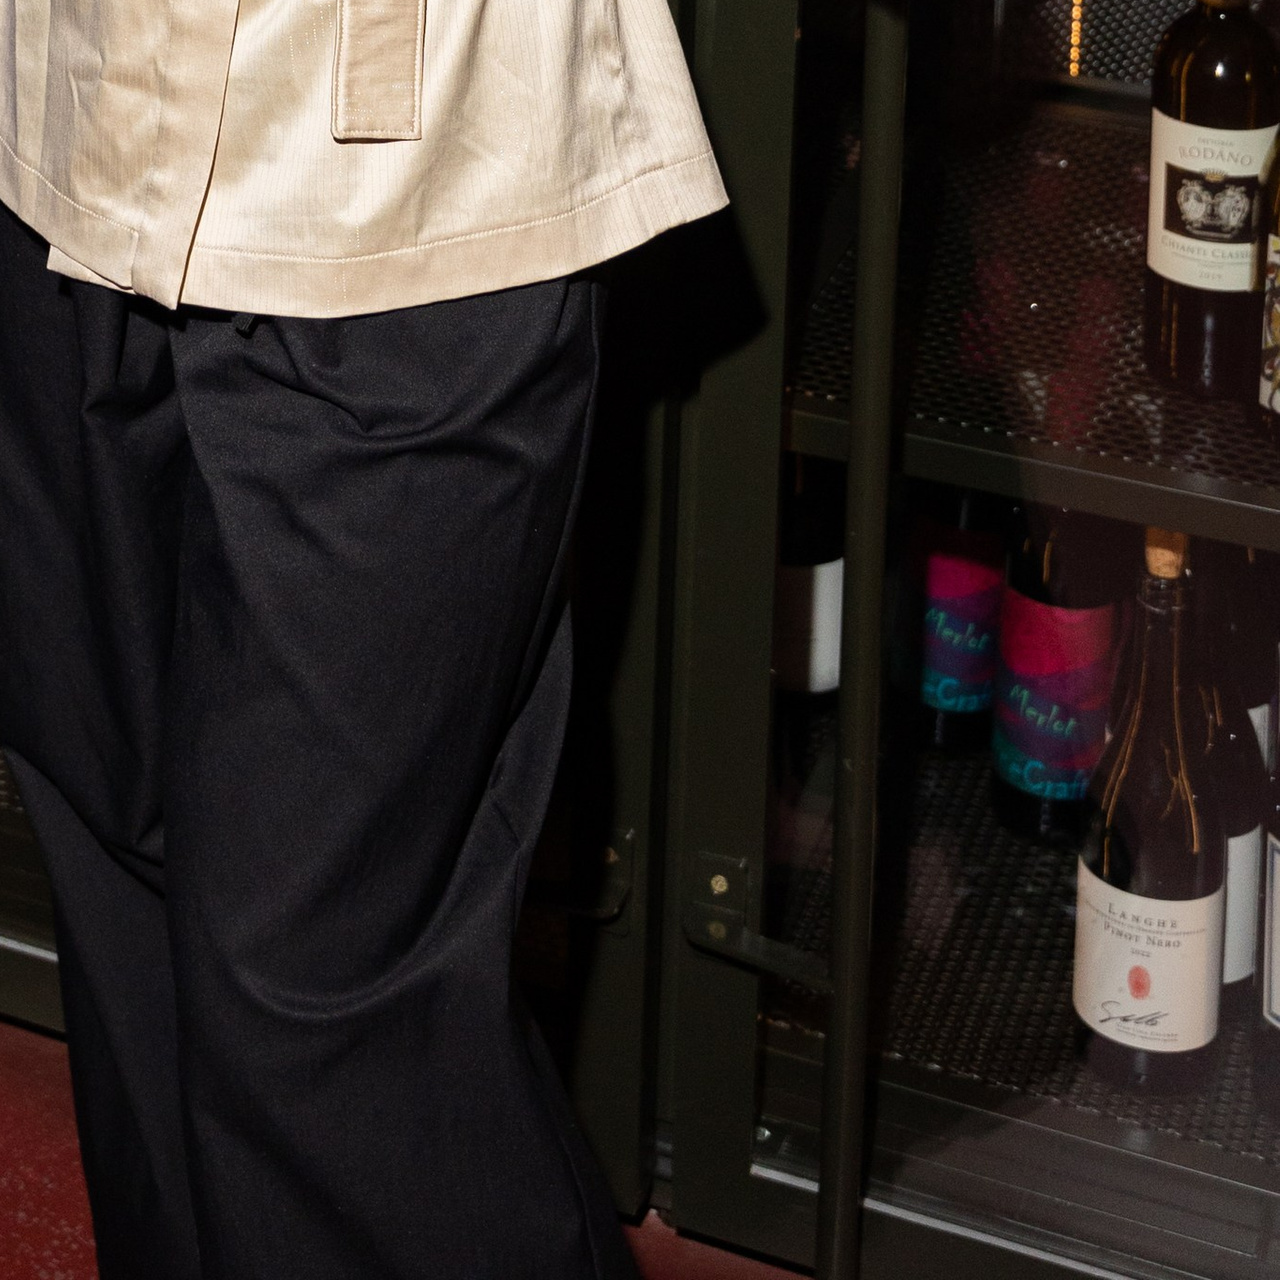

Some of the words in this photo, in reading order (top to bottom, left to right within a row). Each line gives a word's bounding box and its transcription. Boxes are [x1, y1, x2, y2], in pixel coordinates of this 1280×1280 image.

[1178, 145, 1253, 168] RODANO
[1211, 246, 1249, 260] CLASSI
[925, 606, 990, 652] Merlot
[1009, 683, 1077, 738] Merlot
[1108, 902, 1178, 929] LANGHE
[1103, 921, 1141, 944] PINOT
[1146, 934, 1182, 949] NERO
